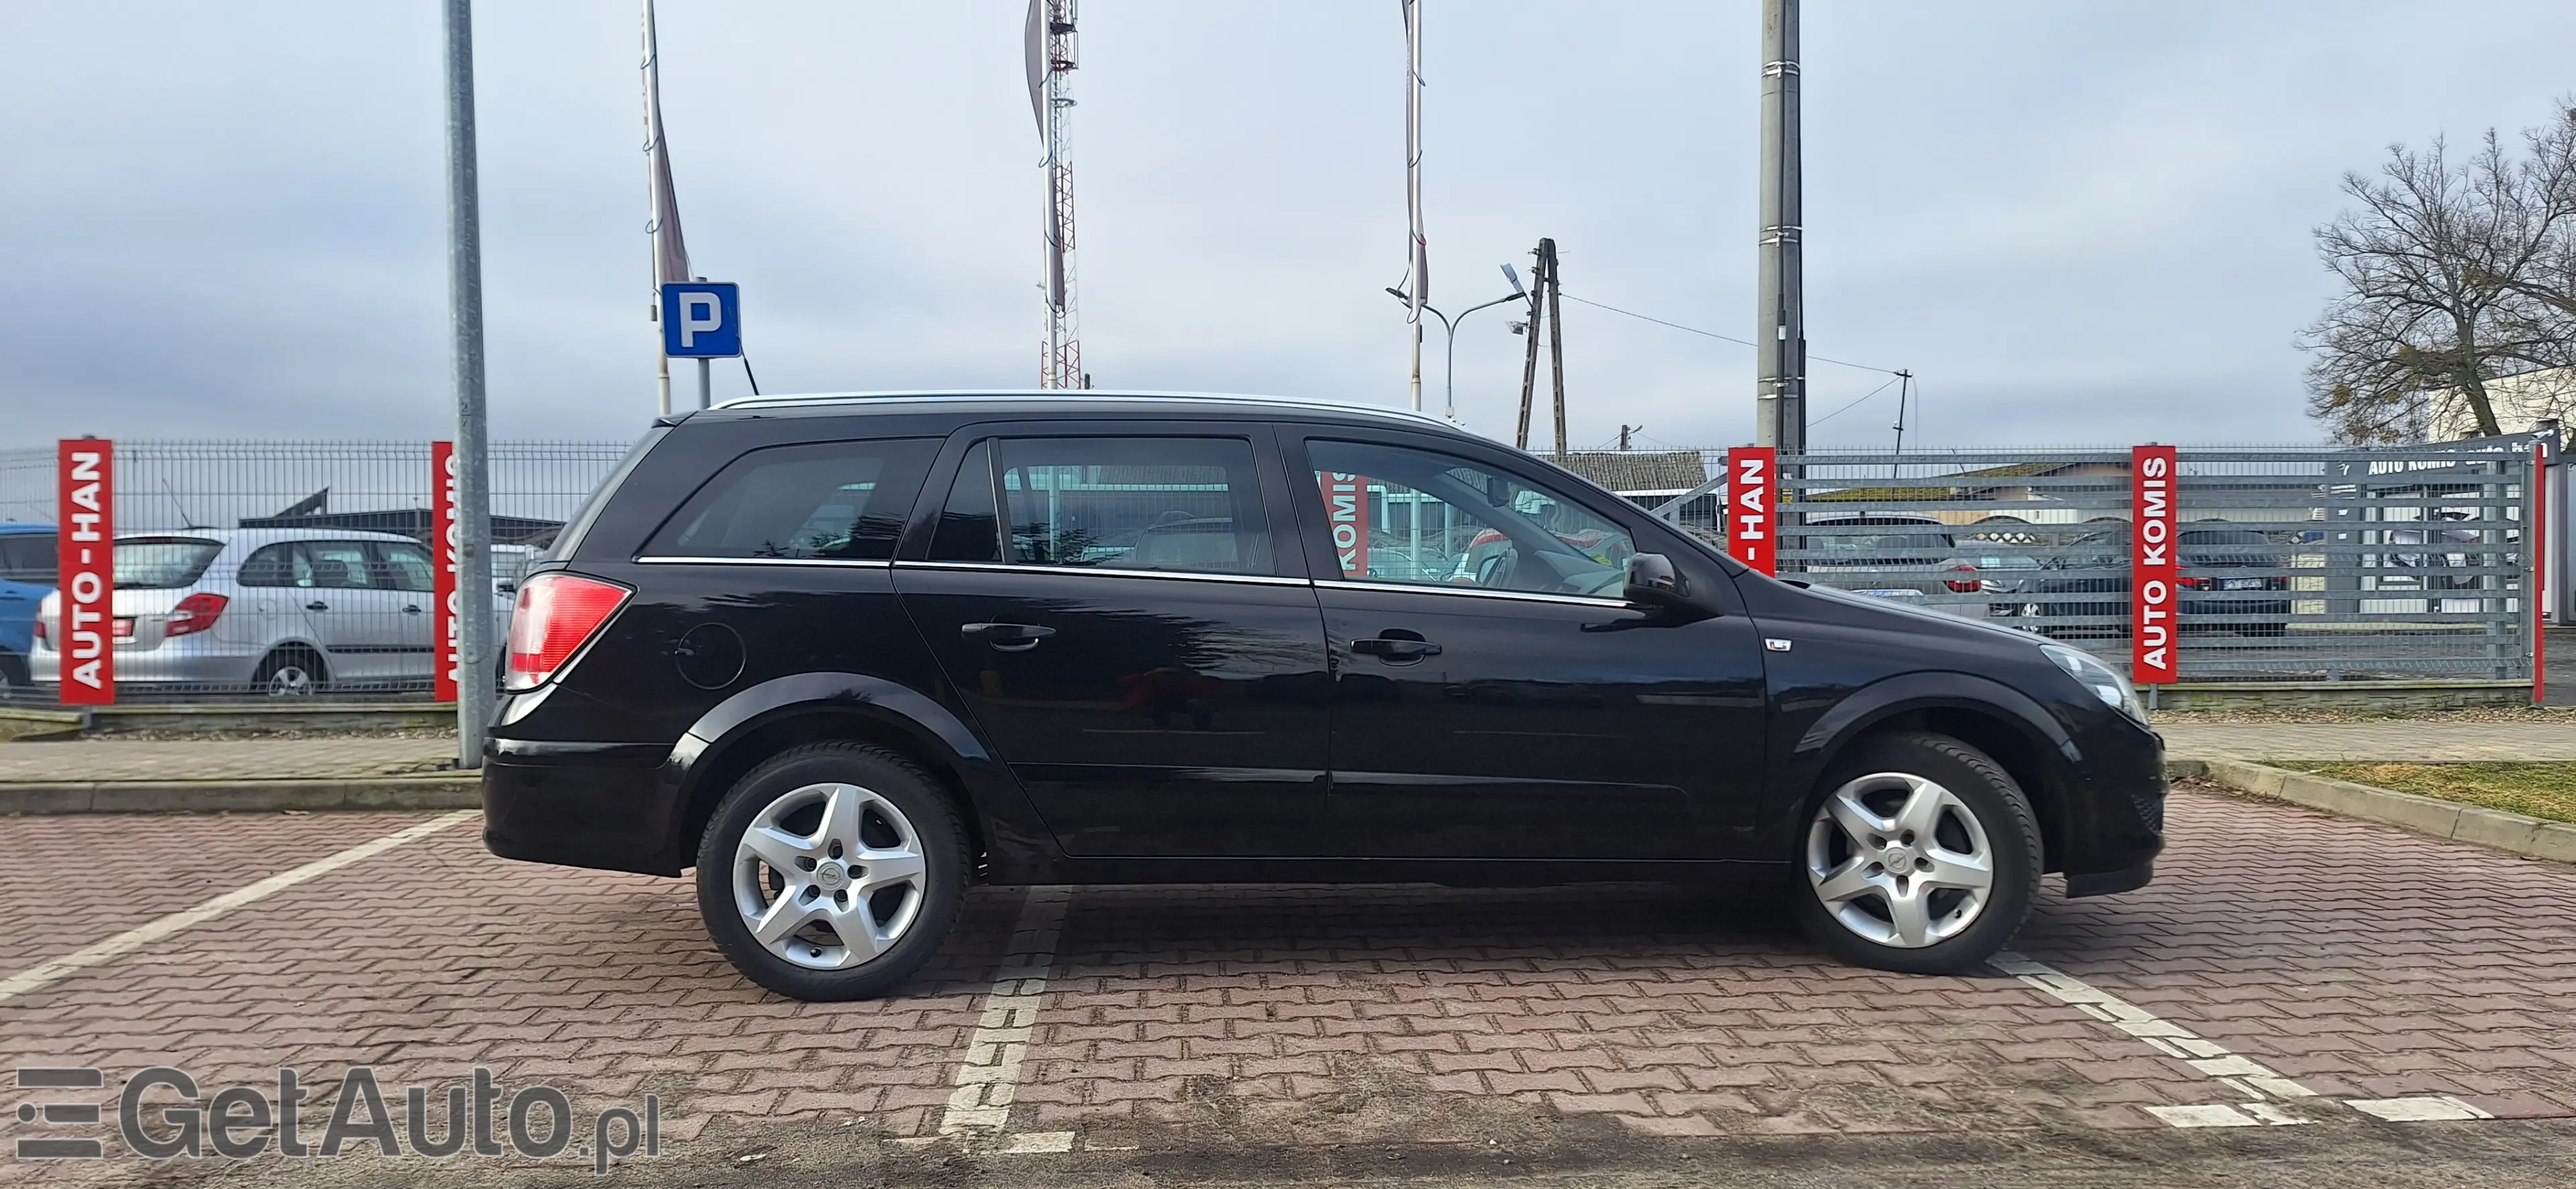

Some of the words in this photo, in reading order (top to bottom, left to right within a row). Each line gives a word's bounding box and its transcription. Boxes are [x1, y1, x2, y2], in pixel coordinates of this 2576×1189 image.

[679, 292, 721, 347] P
[2142, 457, 2167, 565] KOMIS
[2143, 579, 2167, 671] AUTO
